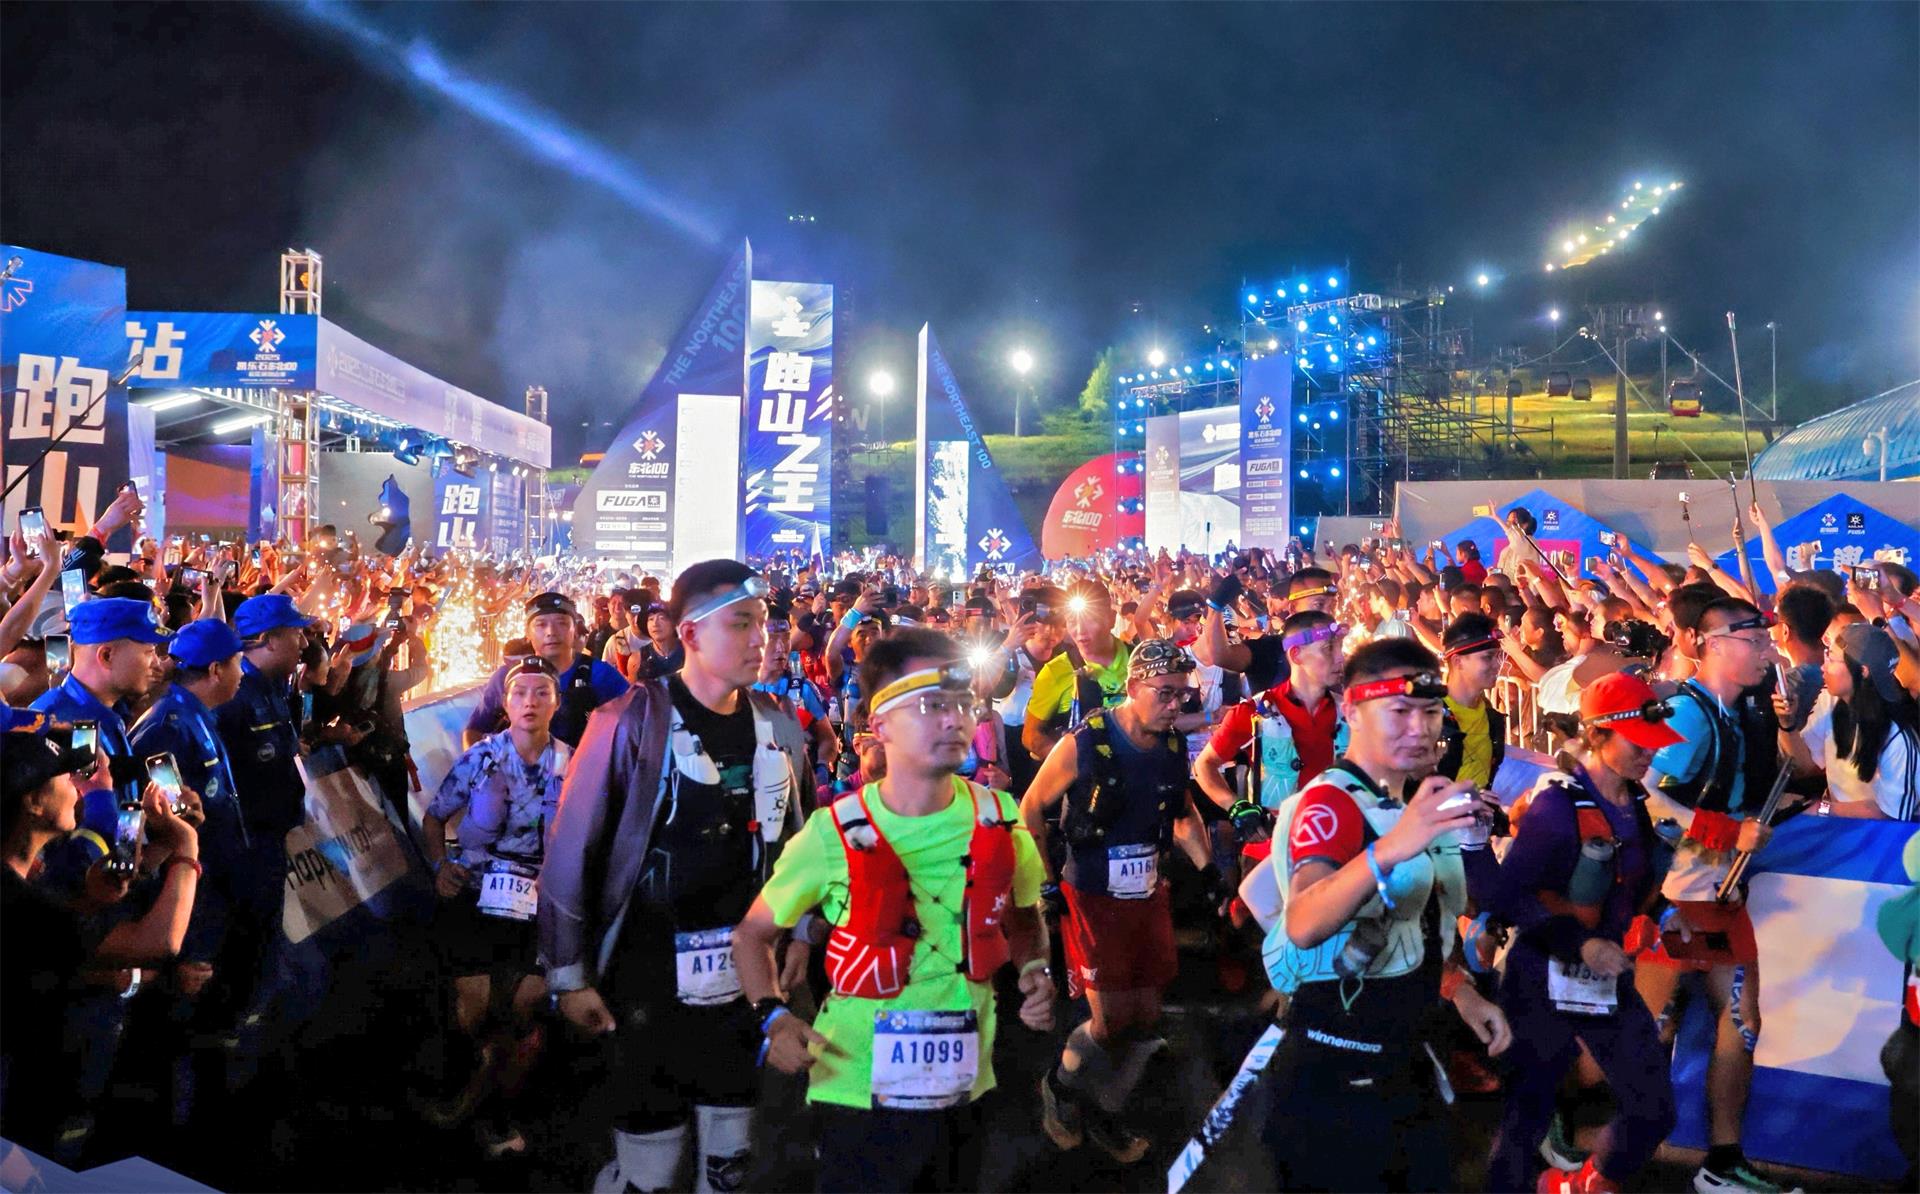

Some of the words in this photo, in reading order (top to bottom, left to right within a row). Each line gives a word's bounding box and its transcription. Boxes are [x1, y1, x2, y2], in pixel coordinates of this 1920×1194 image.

[125, 321, 186, 379] 站
[664, 353, 692, 387] THE
[931, 350, 946, 375] THE
[943, 376, 981, 447] NORTHEAST
[976, 448, 992, 469] 100
[628, 462, 670, 475] 东北100
[602, 495, 647, 507] FUGA
[437, 484, 481, 548] 跑山
[490, 877, 531, 895] A1152
[891, 1040, 963, 1064] A1099
[1307, 1029, 1383, 1053] winnermara
